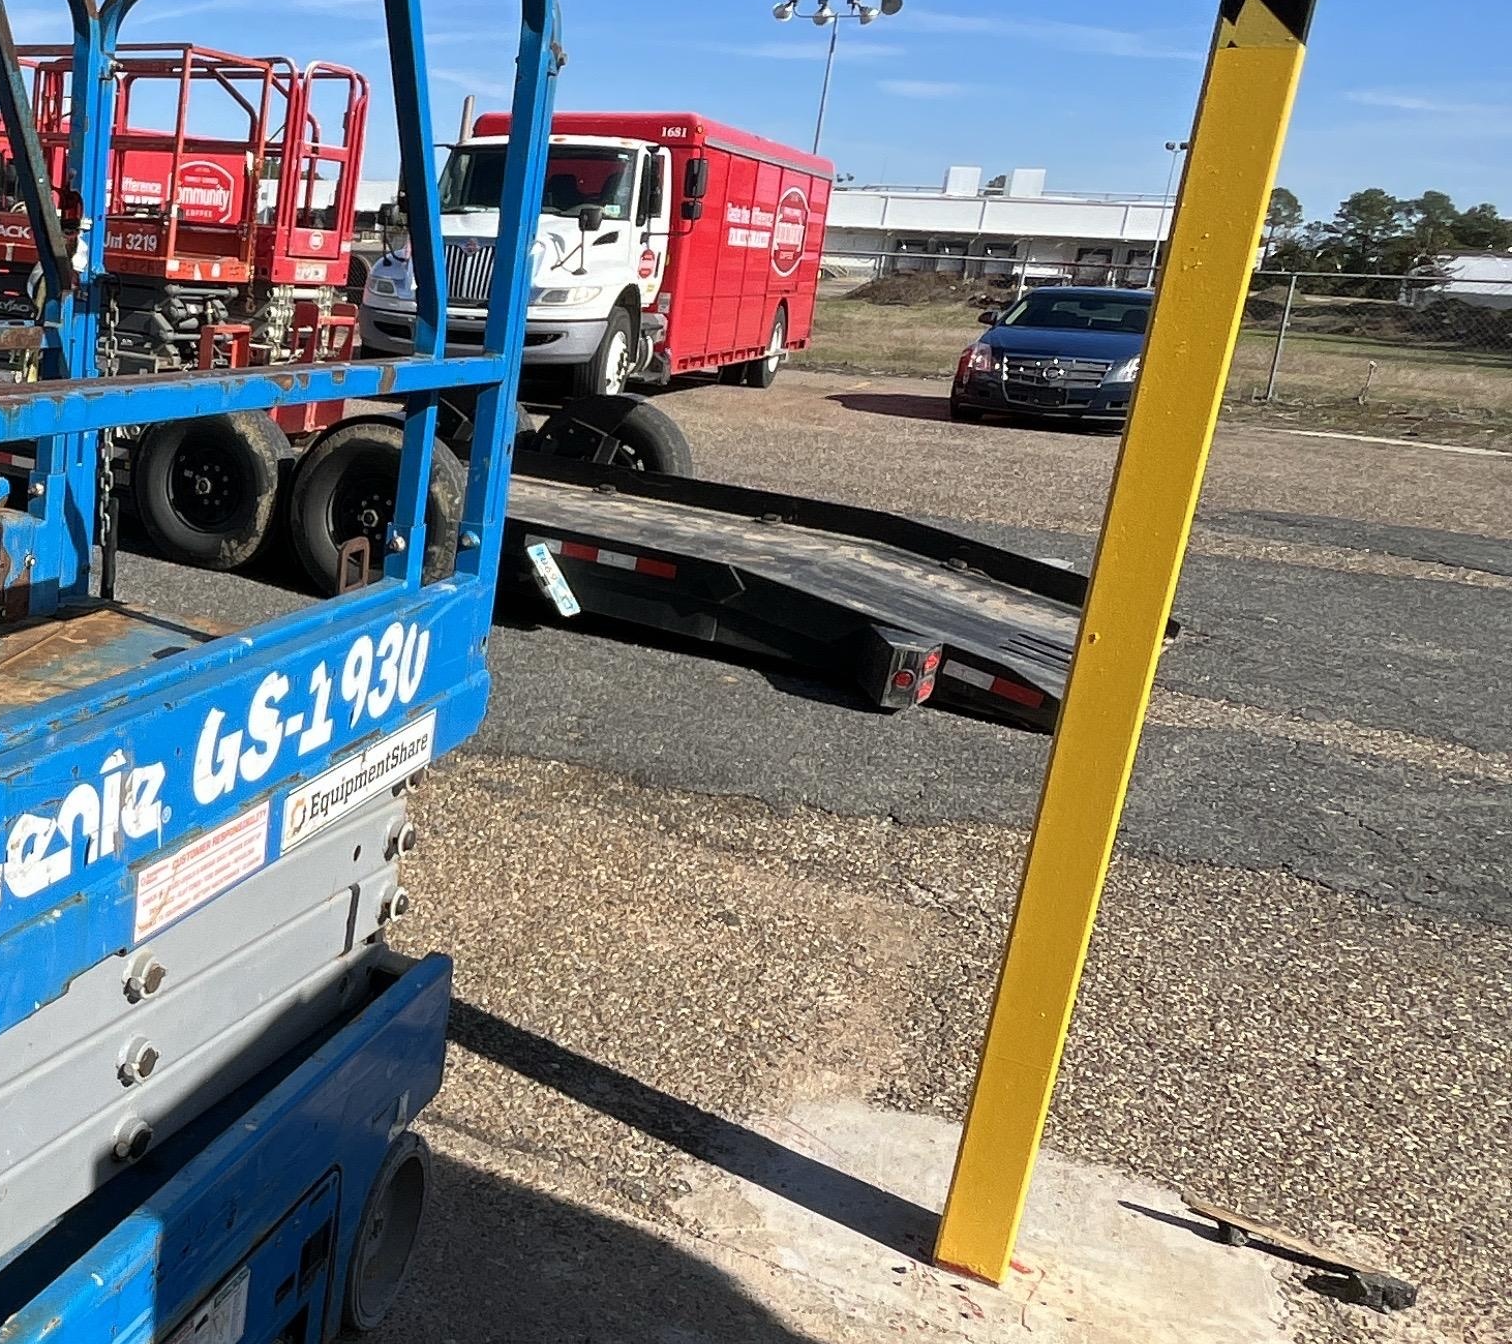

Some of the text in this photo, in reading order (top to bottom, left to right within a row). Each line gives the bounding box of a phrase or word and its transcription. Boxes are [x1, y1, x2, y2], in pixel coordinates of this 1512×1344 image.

[661, 126, 688, 138] 1681
[125, 232, 158, 252] 3219
[309, 732, 429, 820] EquipmentShare
